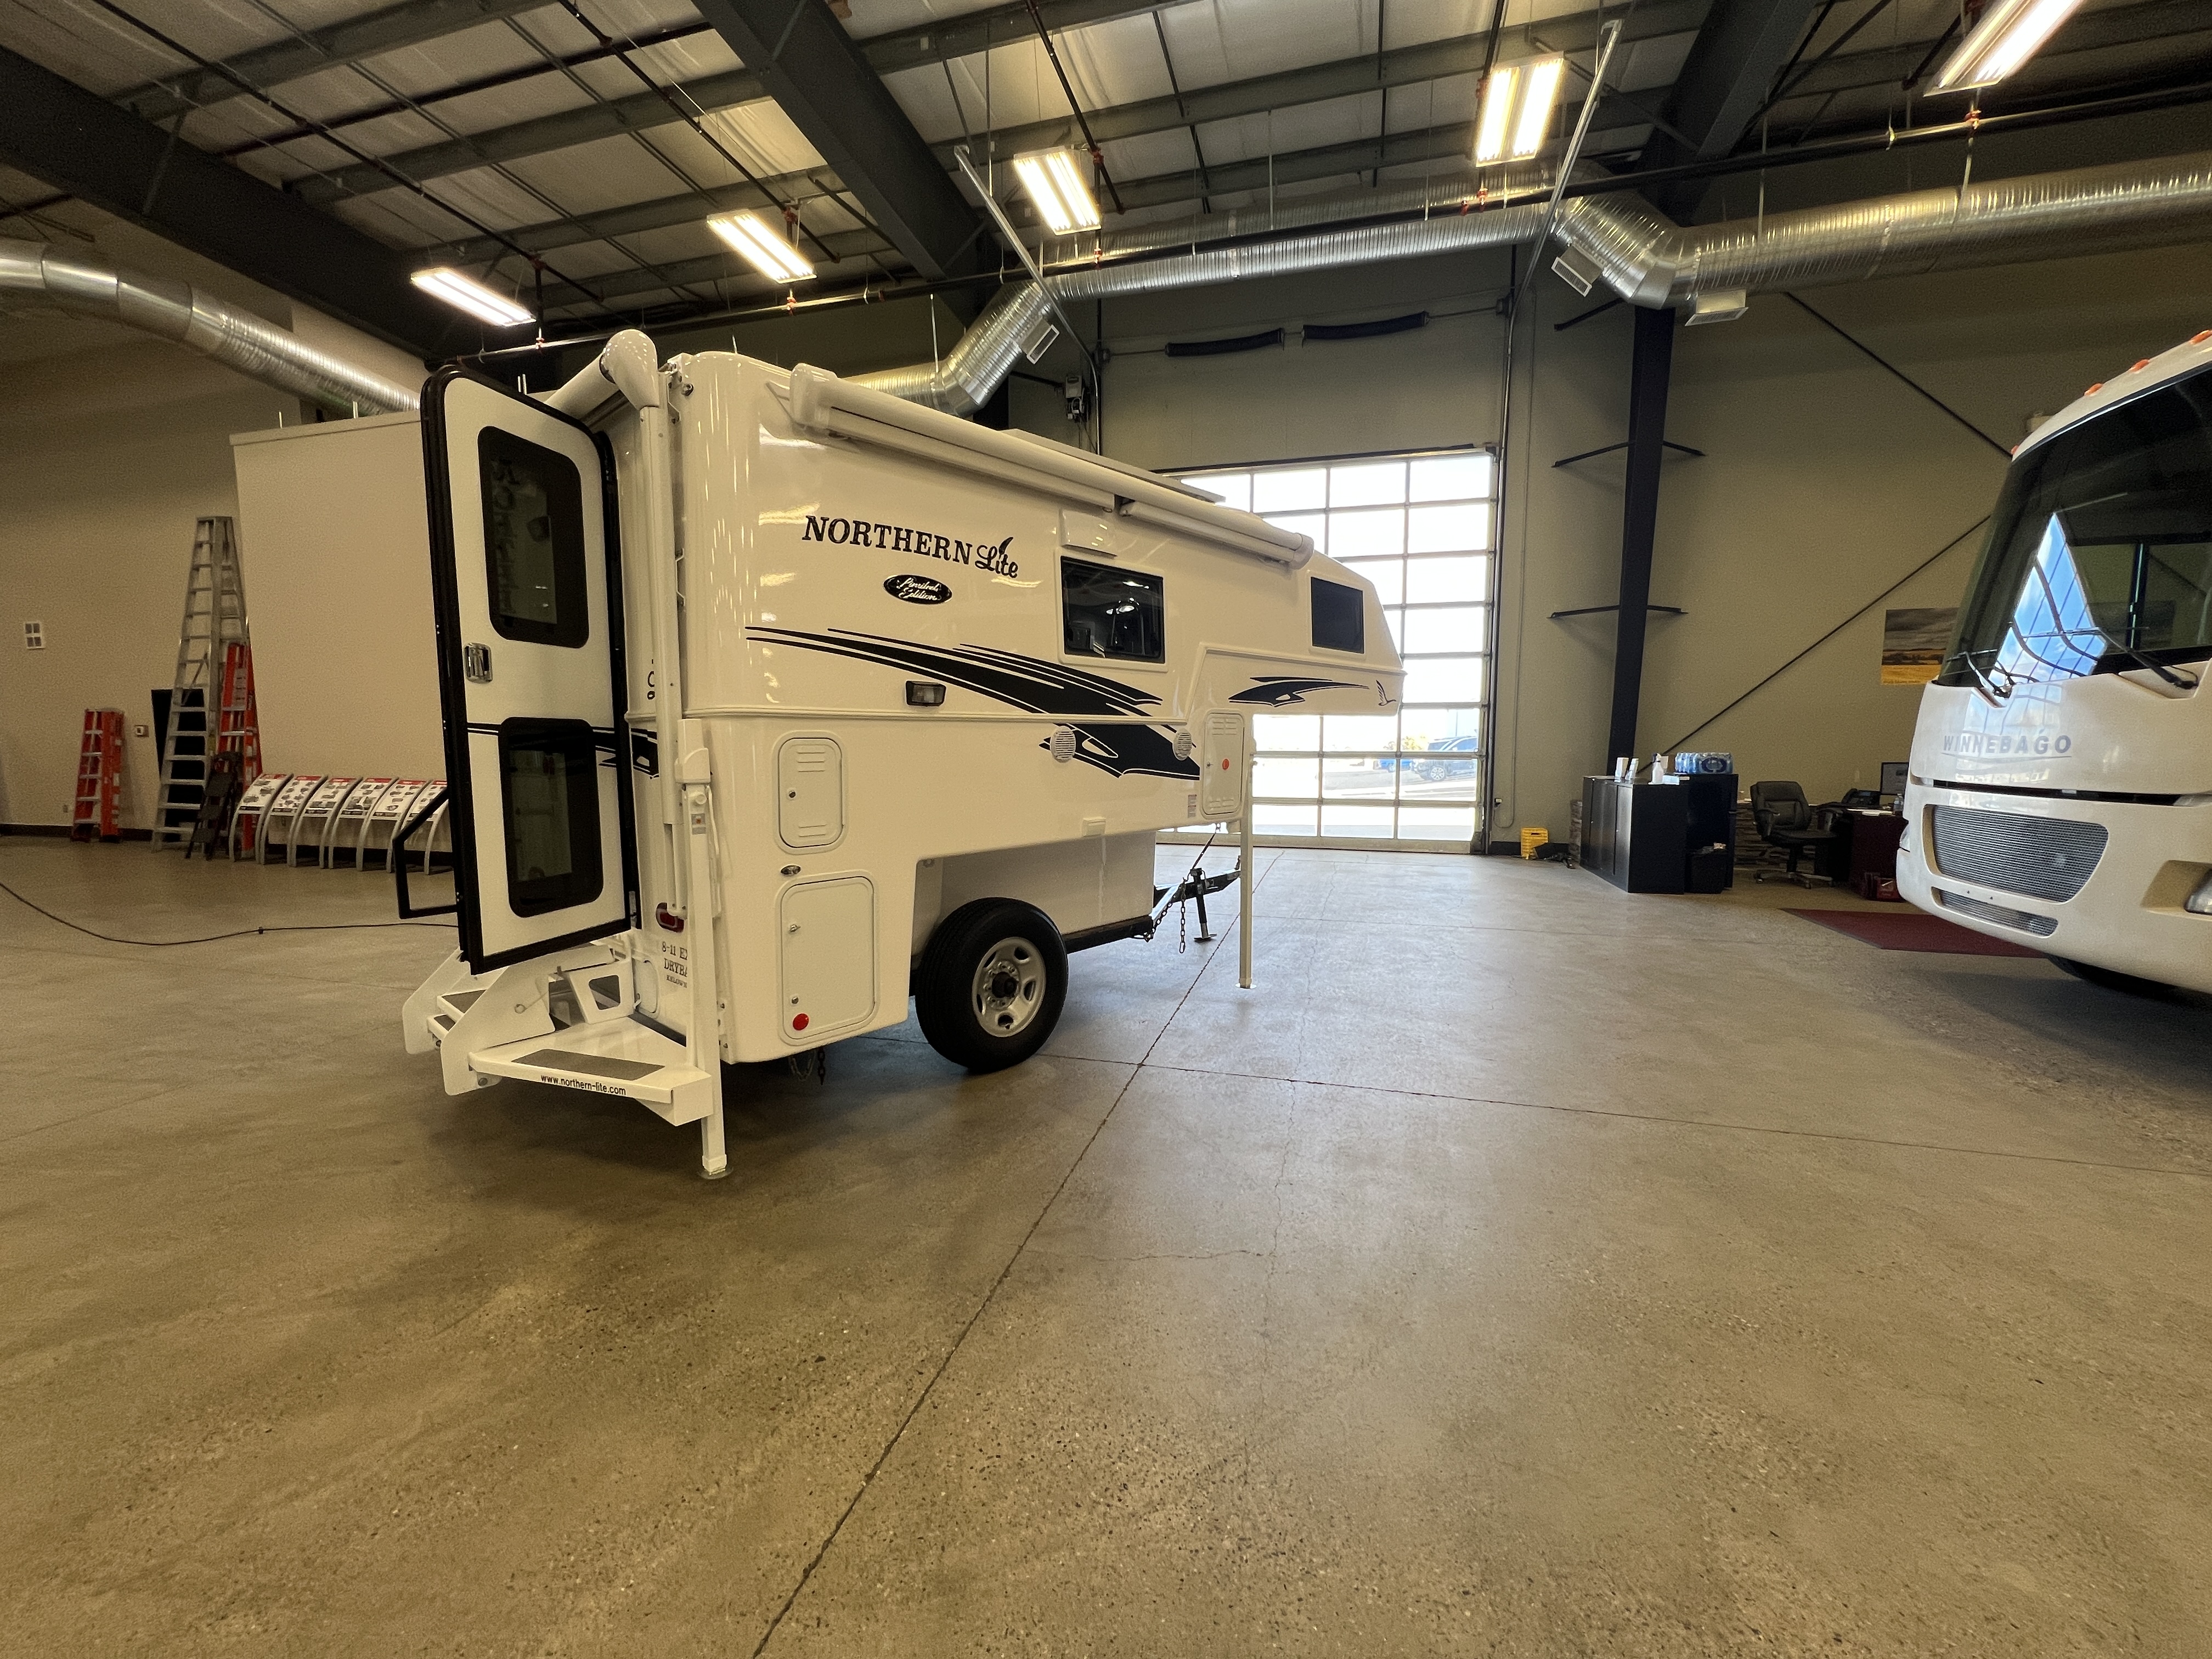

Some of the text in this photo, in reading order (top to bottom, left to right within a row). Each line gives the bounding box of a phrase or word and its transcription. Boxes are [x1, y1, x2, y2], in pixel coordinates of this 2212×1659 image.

[802, 515, 1019, 578] NORTHERN Lite
[898, 588, 938, 601] Edition
[1943, 735, 2072, 755] WINNEBAGO
[662, 941, 676, 956] 8-11
[540, 1074, 627, 1096] www.northern-lite.com
